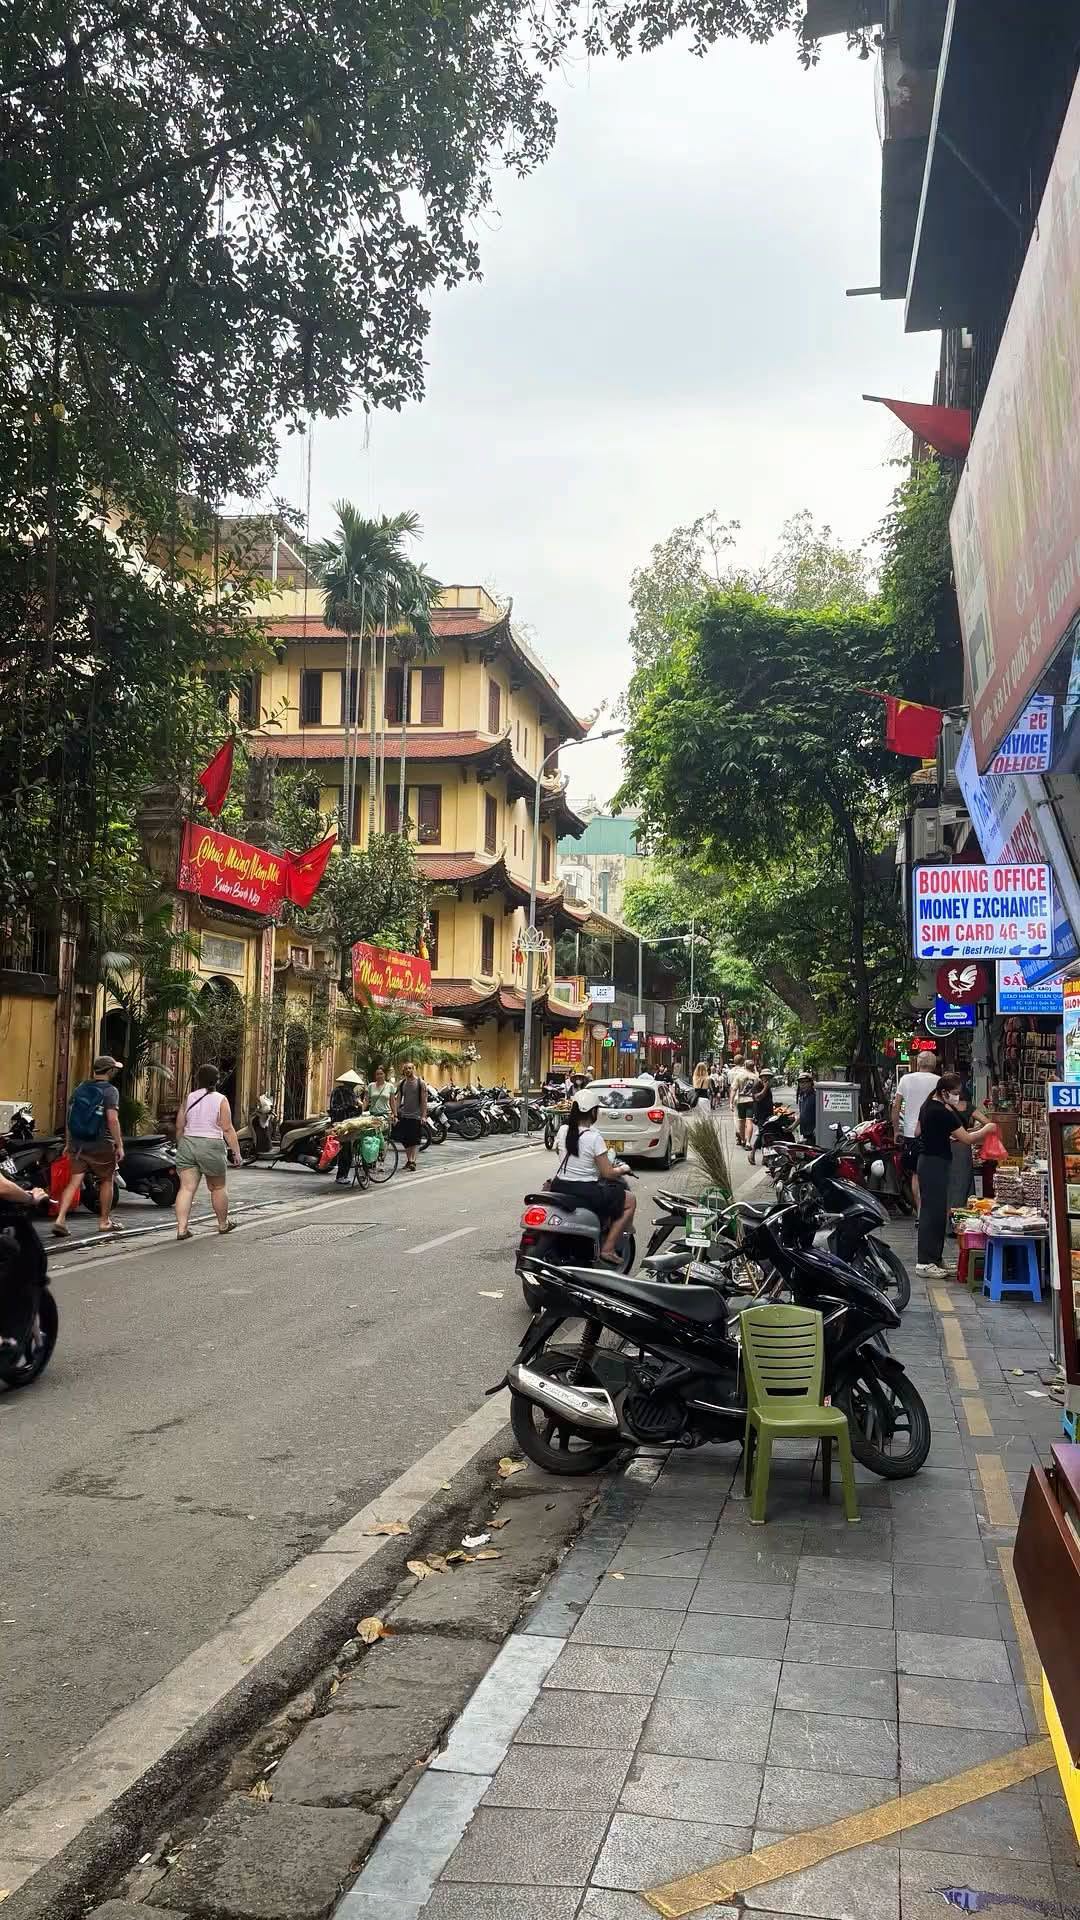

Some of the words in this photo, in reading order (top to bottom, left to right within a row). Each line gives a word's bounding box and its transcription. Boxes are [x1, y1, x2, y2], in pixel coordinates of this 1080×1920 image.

[919, 869, 989, 894] BOOKING
[994, 867, 1047, 892] OFFICE
[919, 898, 969, 920] MONEY
[973, 896, 1048, 918] EXCHANGE
[921, 924, 950, 942] SIM
[955, 923, 995, 941] CARD
[962, 945, 982, 956] (Best
[983, 945, 1007, 955] Price)
[1059, 1088, 1080, 1105] SI
